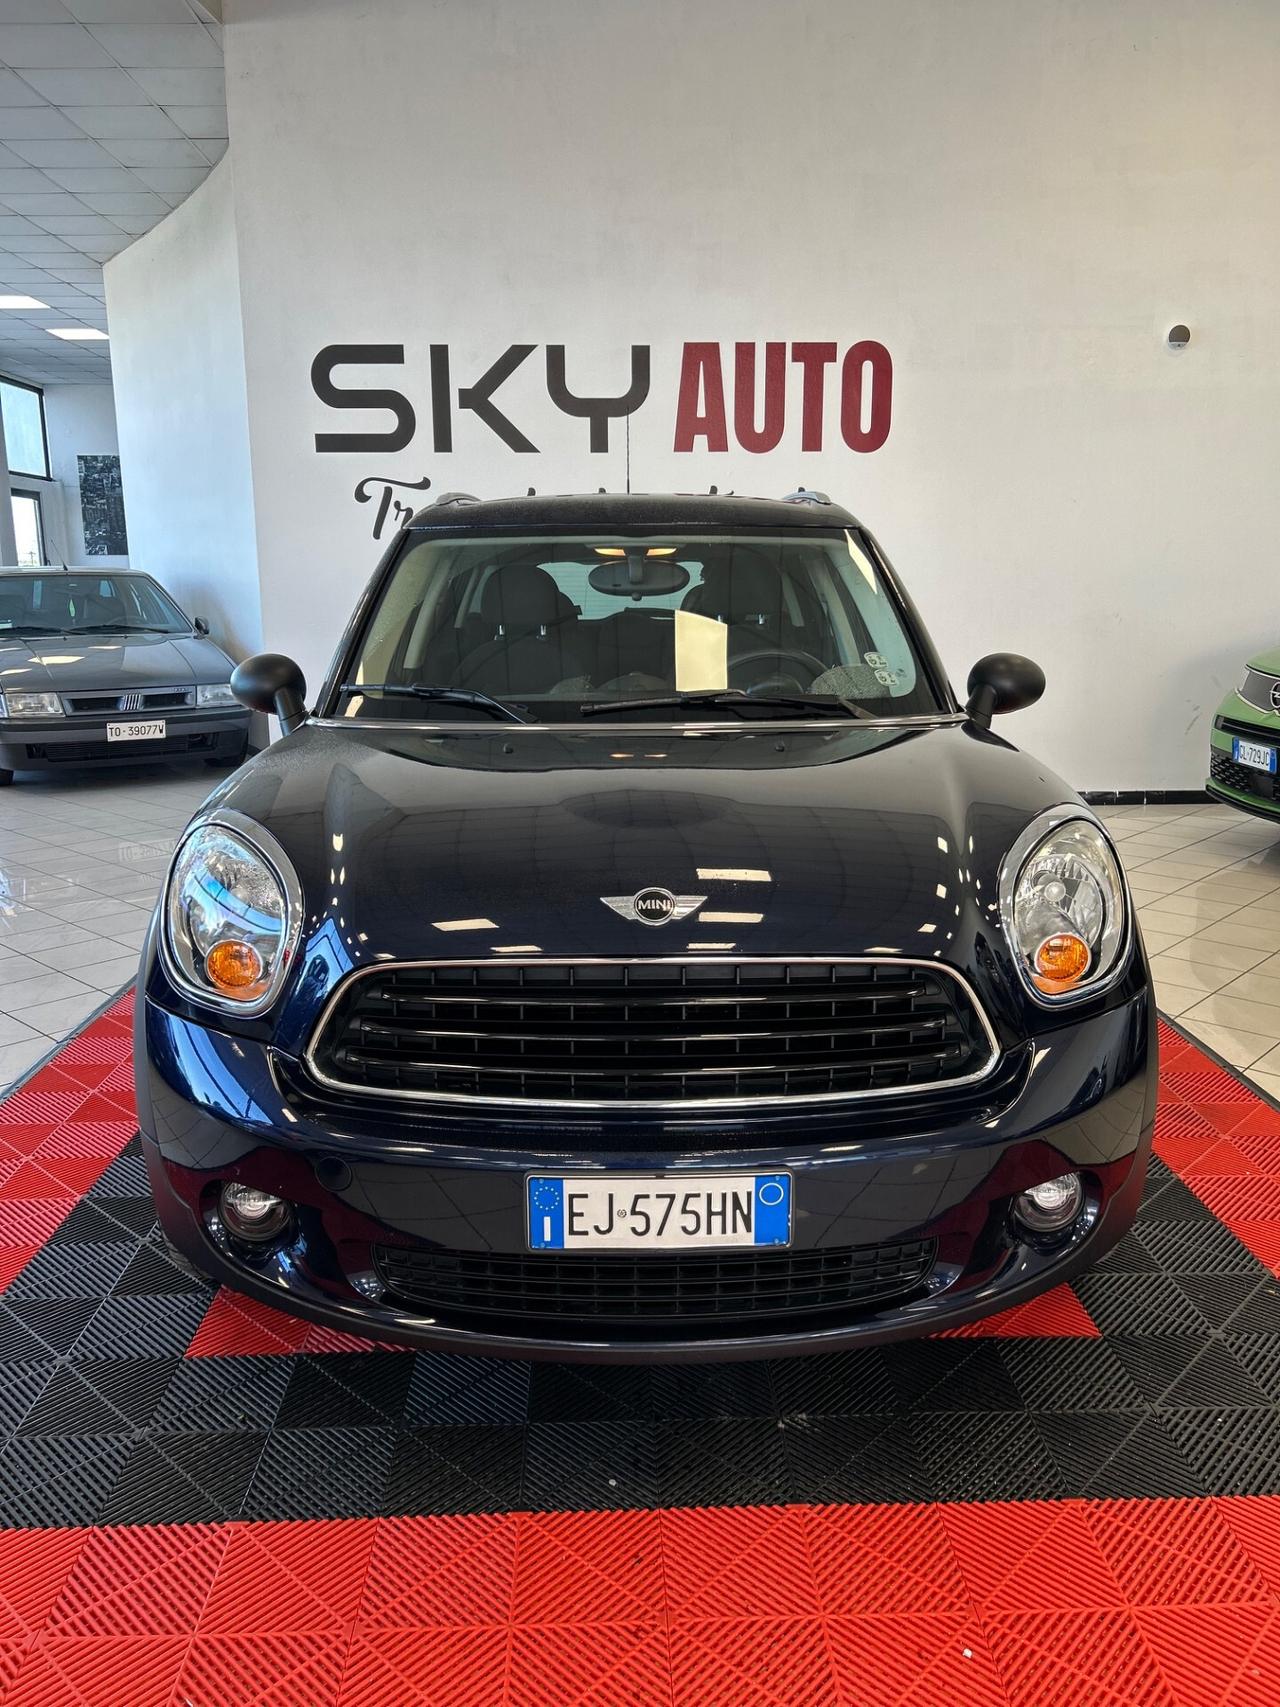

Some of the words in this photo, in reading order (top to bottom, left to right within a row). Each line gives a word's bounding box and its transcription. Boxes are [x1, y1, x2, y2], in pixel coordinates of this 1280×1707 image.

[310, 343, 651, 454] SKY
[673, 340, 893, 454] AUTO
[637, 899, 672, 911] MINI
